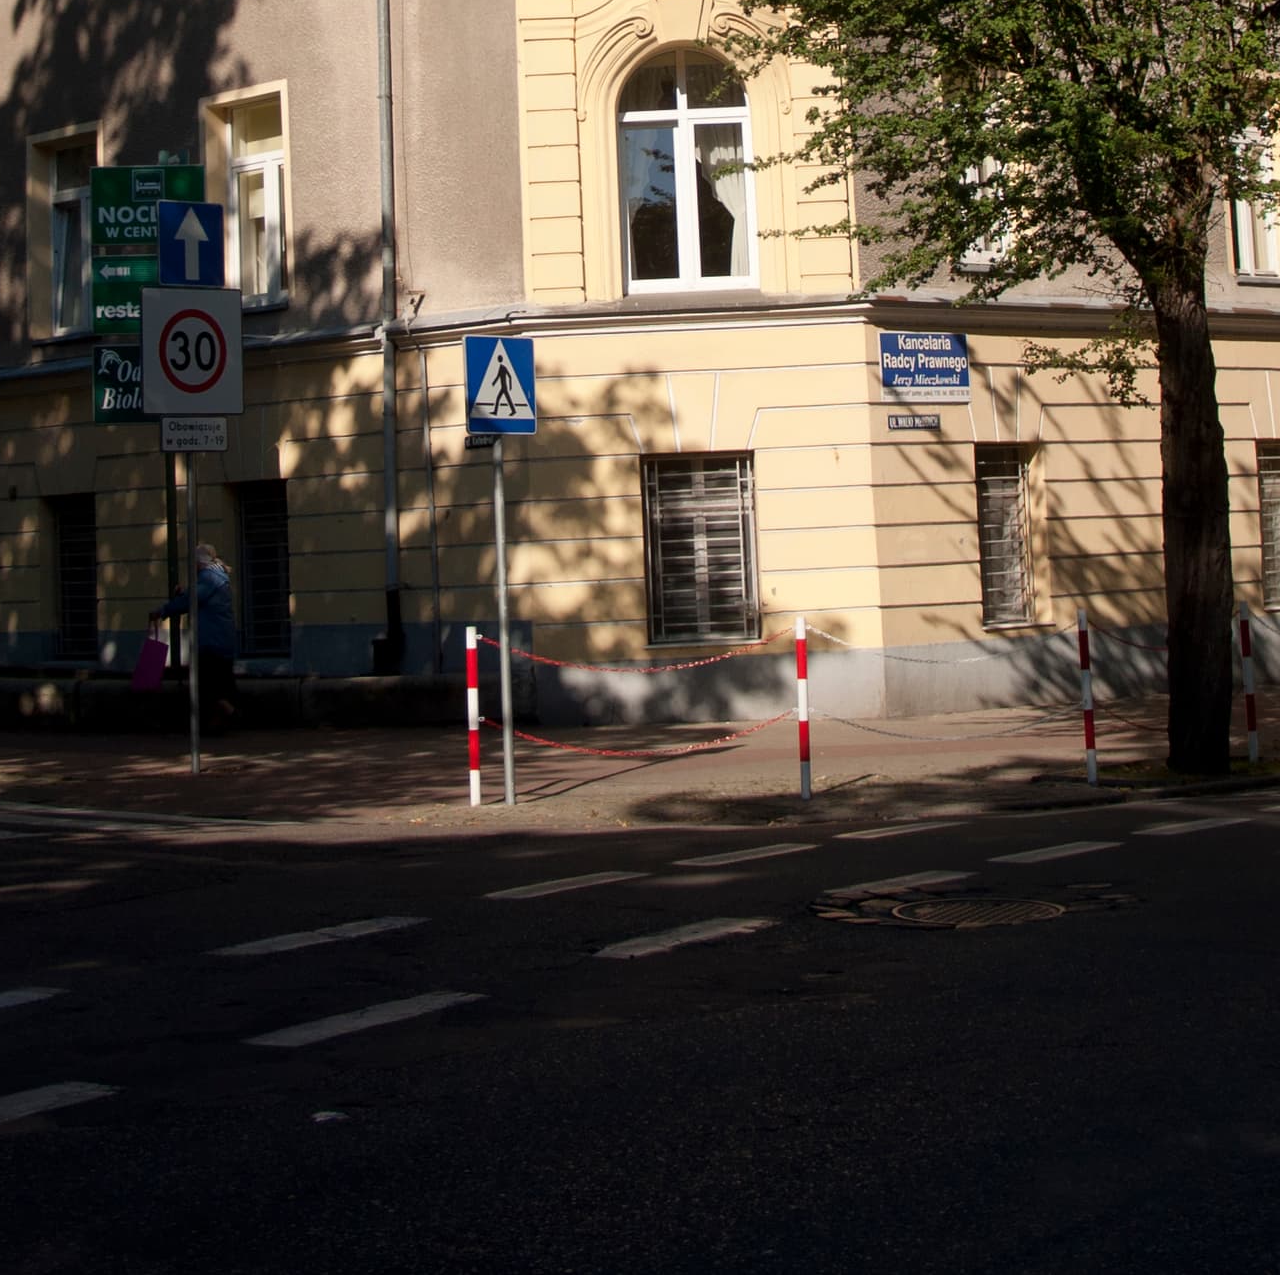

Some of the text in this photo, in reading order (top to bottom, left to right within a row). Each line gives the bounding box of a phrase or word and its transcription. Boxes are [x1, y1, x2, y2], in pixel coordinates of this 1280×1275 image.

[105, 227, 119, 238] W
[897, 334, 951, 351] Kancelaria
[170, 331, 216, 372] 30
[883, 352, 967, 372] Radcy Prawnego
[892, 374, 913, 387] Jerzy
[168, 420, 222, 434] Obowiązuje
[176, 436, 201, 448] godz.
